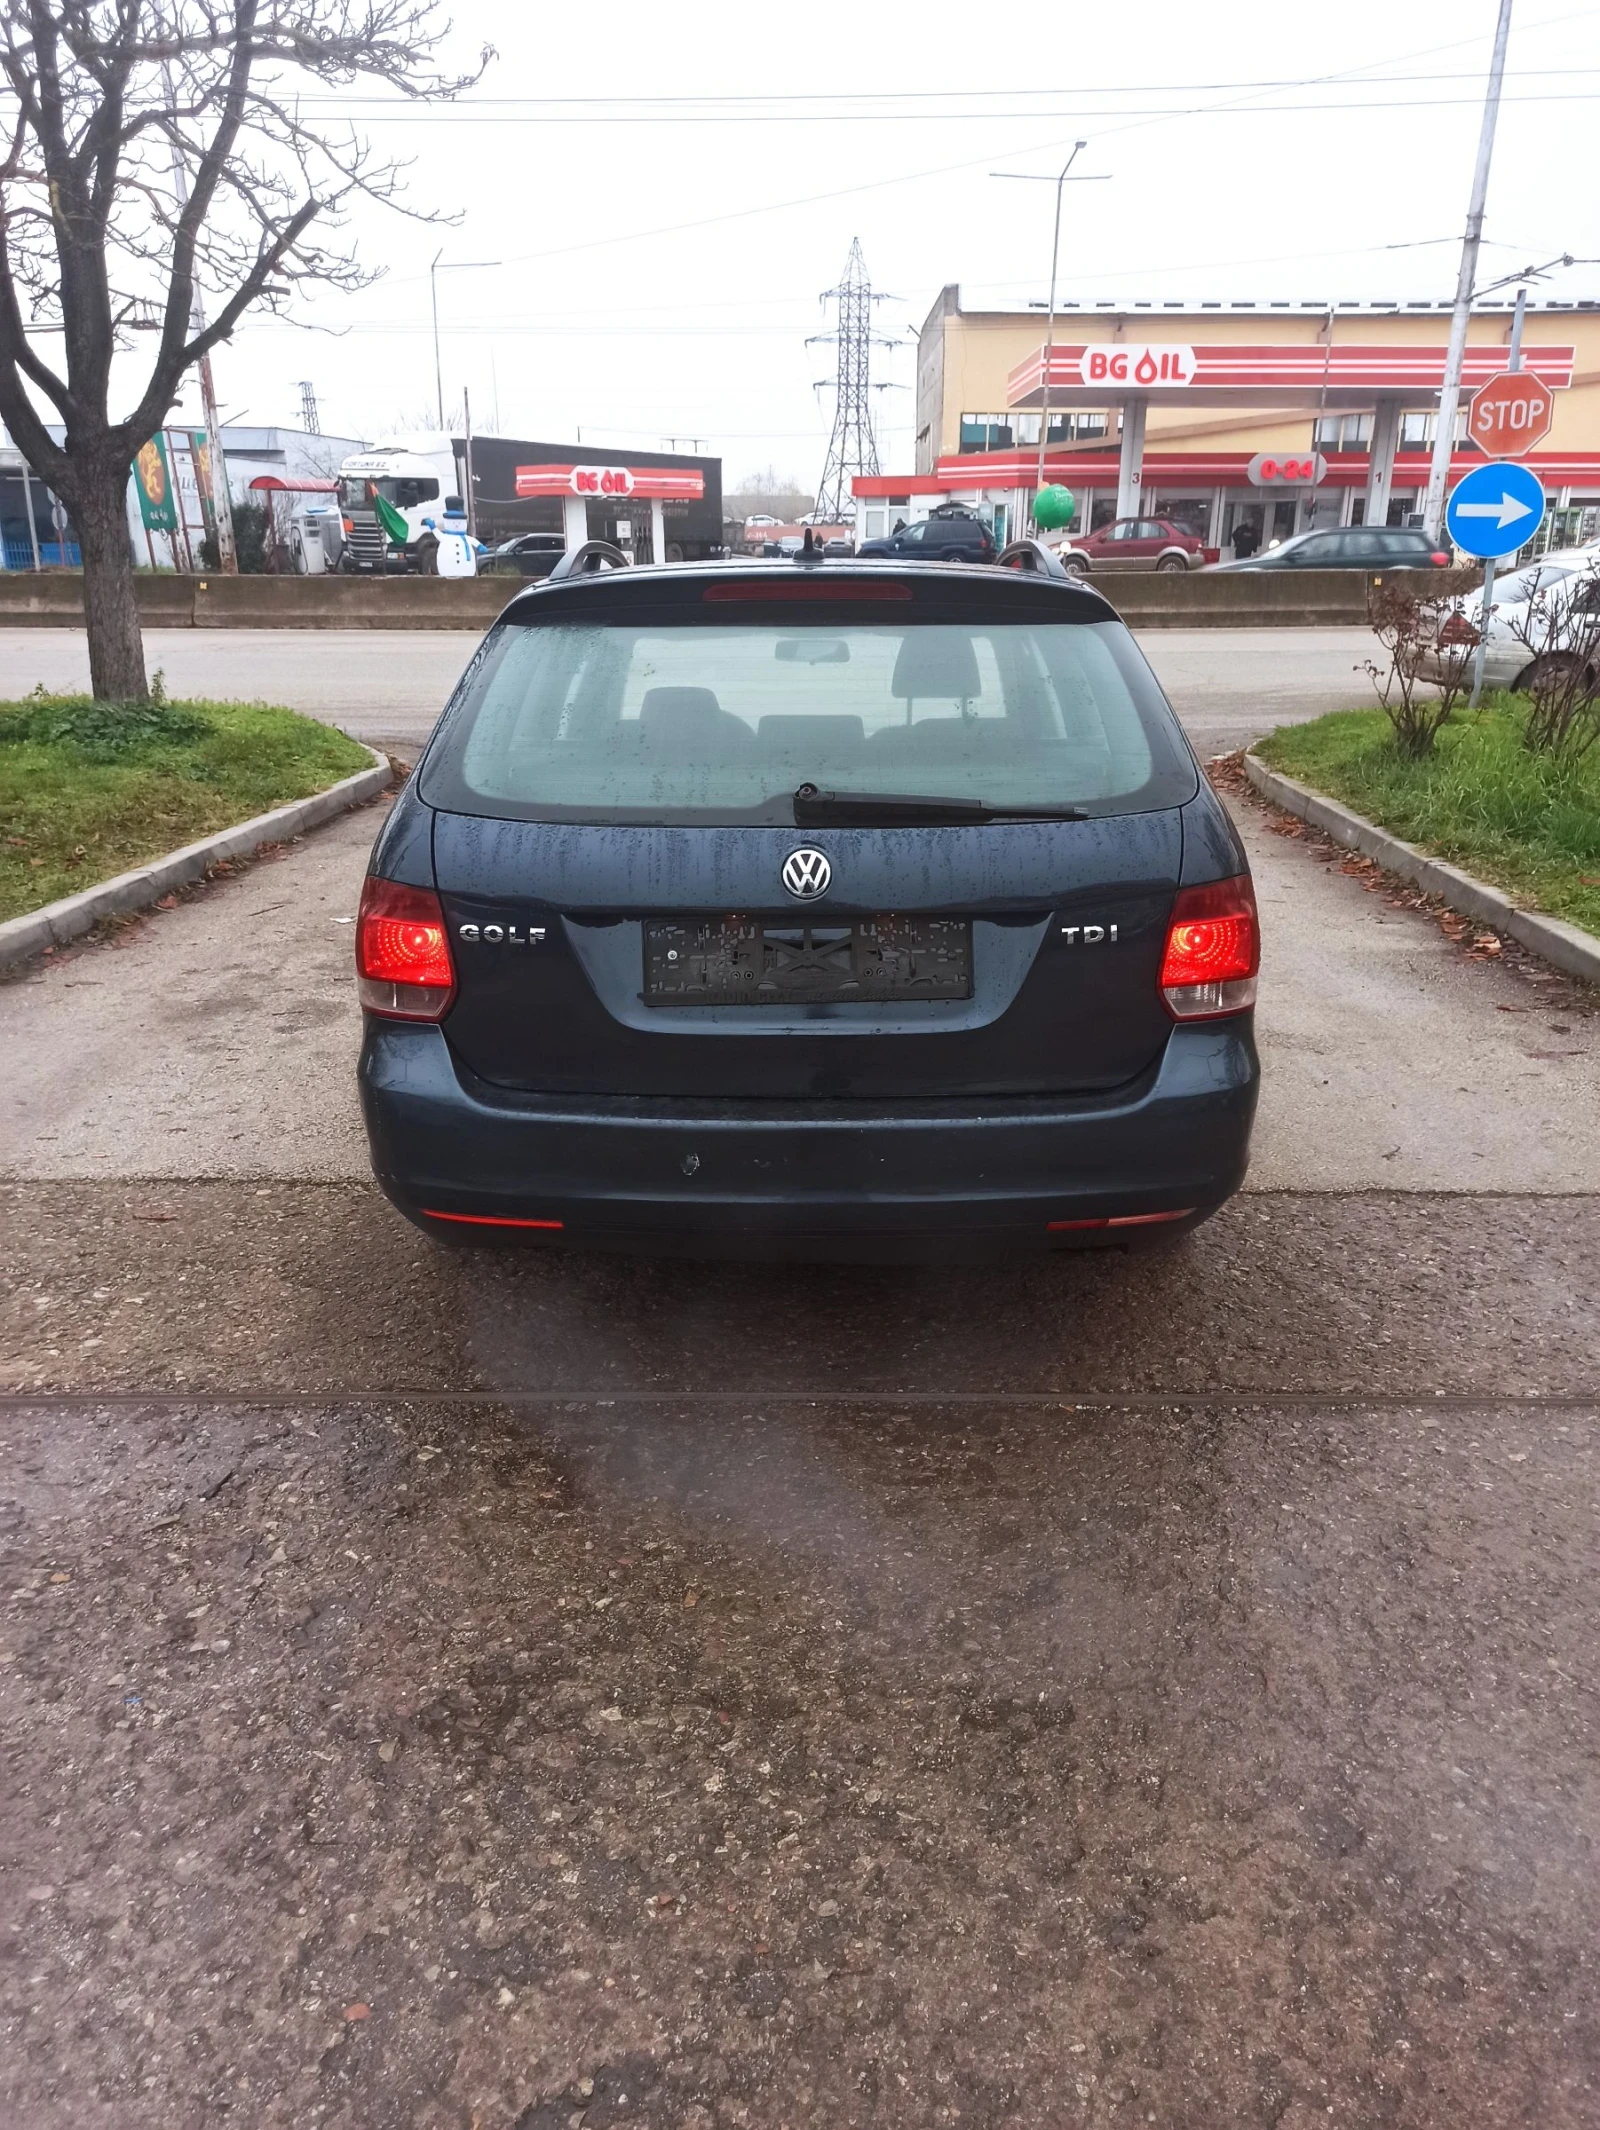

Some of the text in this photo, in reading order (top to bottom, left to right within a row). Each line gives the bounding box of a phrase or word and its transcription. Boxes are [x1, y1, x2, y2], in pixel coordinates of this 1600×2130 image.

[1090, 348, 1186, 384] BG OIL
[1477, 399, 1545, 431] STOP
[1131, 472, 1140, 484] 3
[1260, 459, 1313, 480] 0-24
[1375, 471, 1382, 483] 1
[577, 469, 630, 494] BG OIL
[459, 924, 546, 945] GOLF
[1061, 924, 1118, 945] TDI
